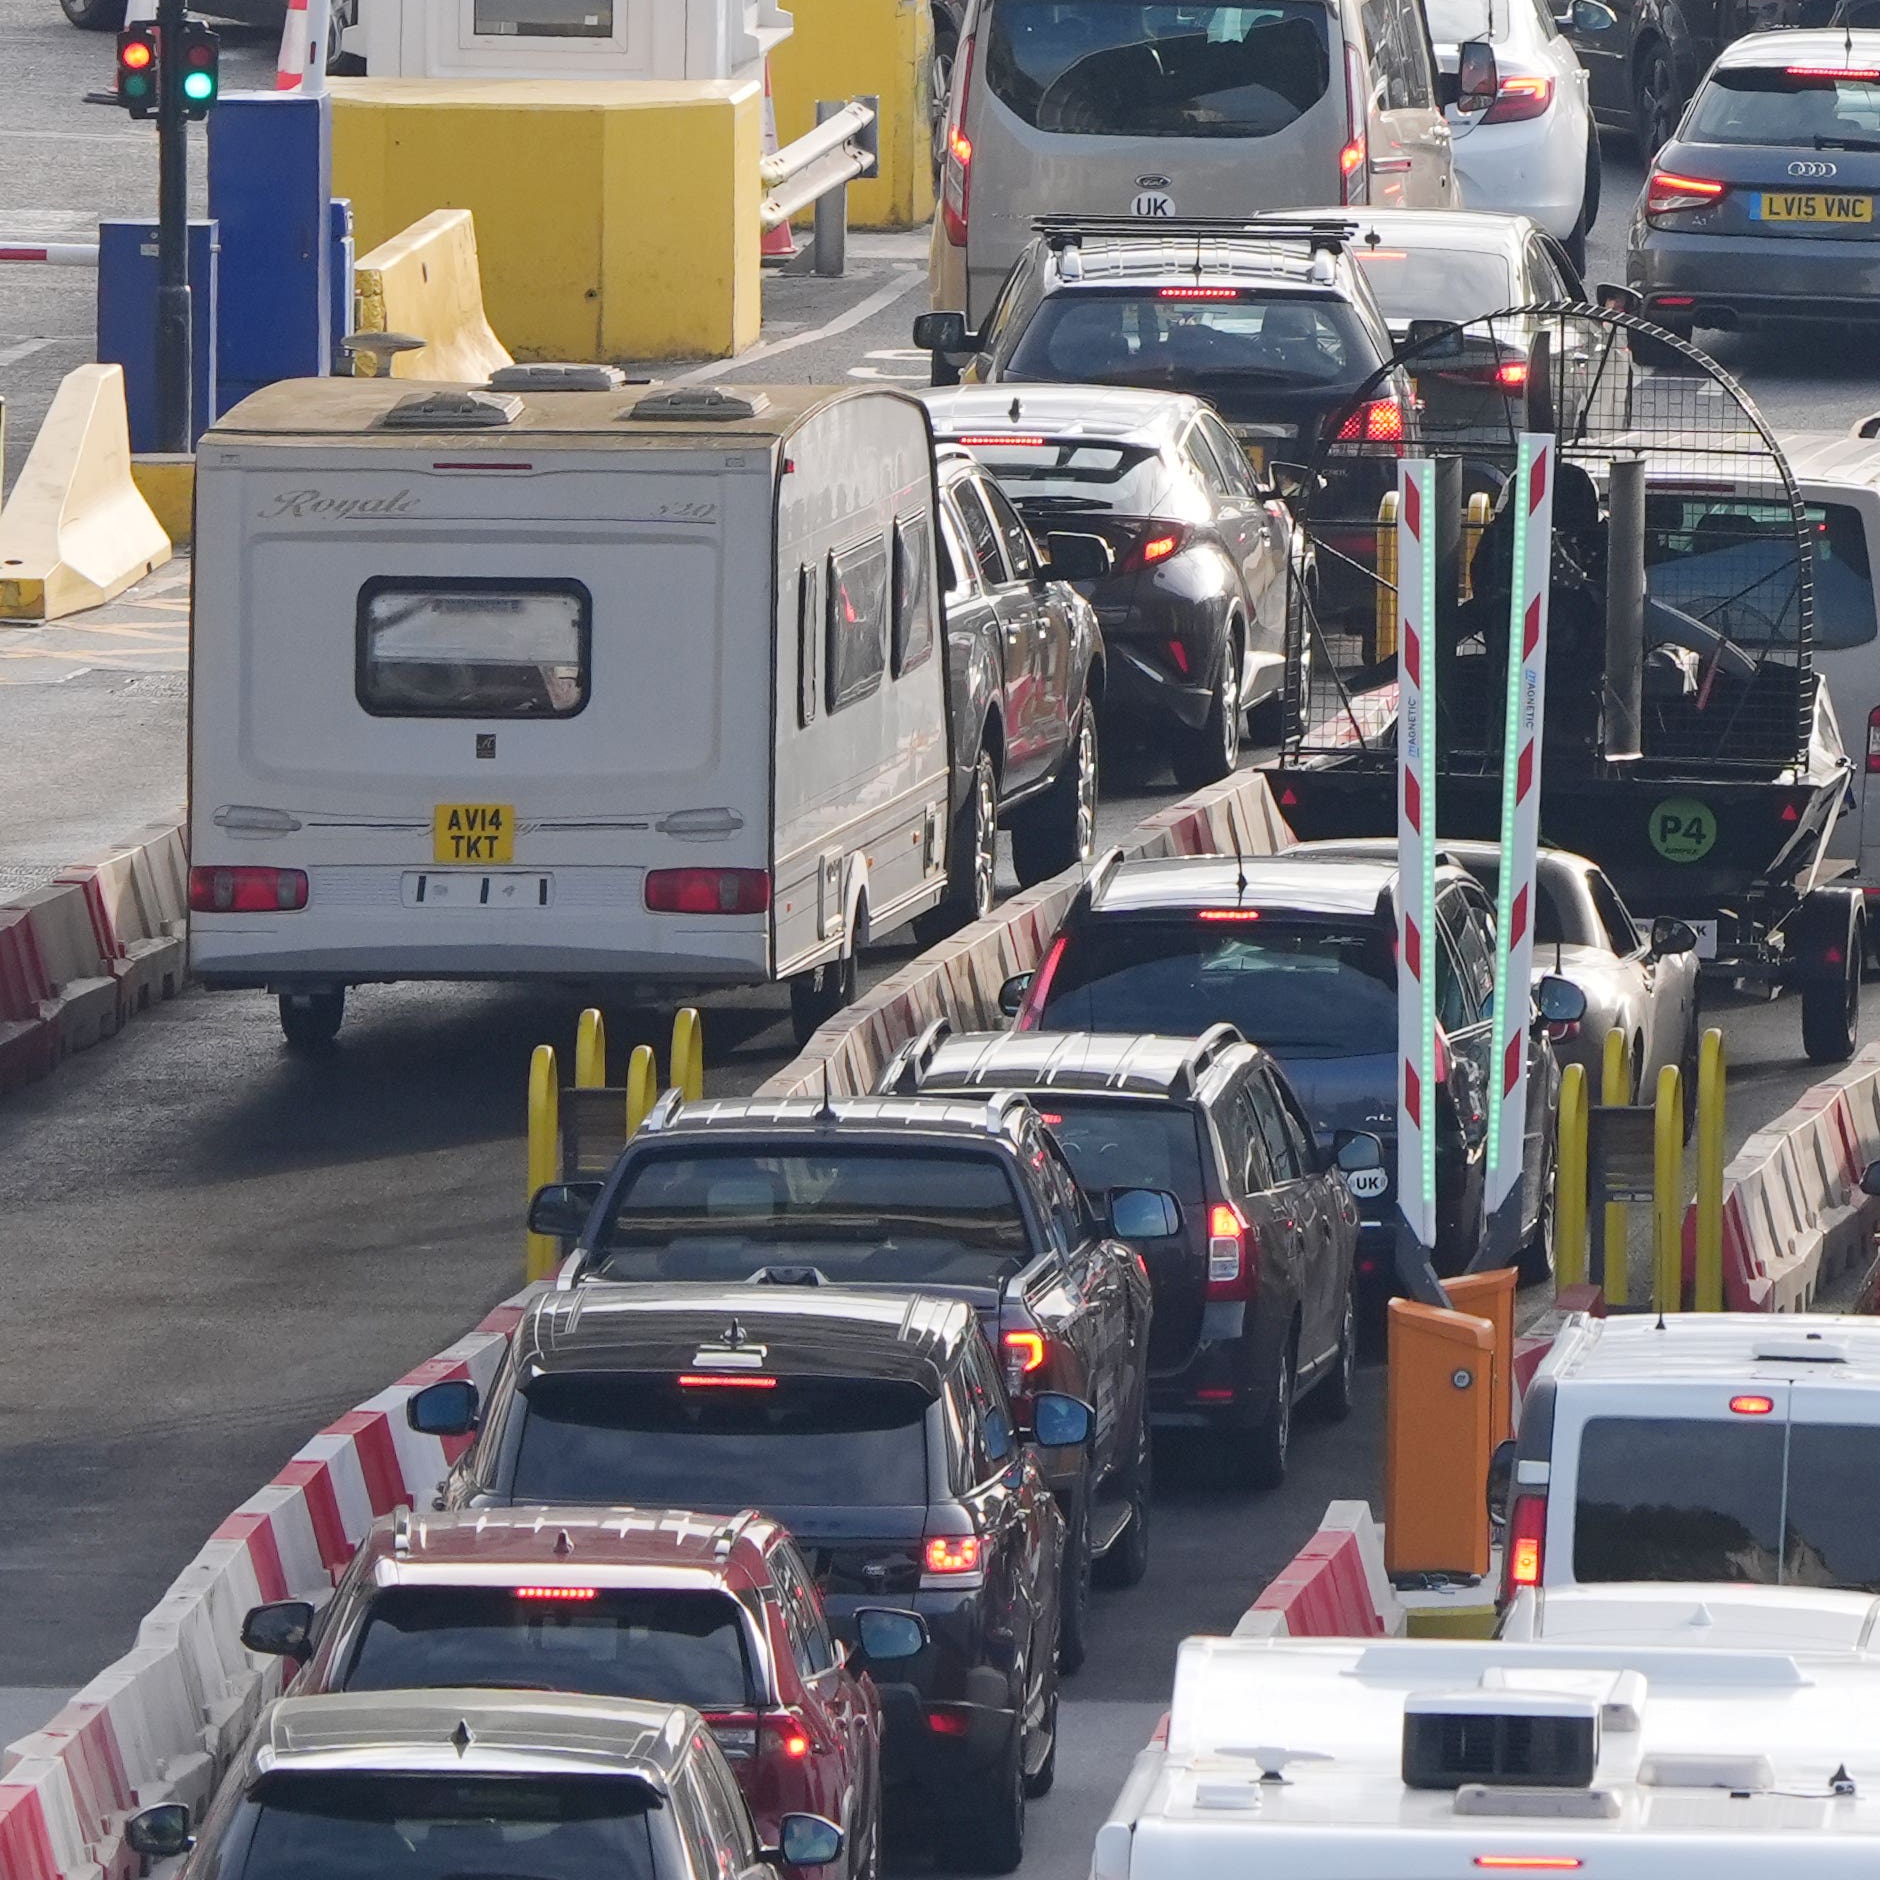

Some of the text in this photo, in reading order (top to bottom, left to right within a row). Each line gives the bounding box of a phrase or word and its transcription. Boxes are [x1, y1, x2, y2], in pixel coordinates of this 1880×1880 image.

[1138, 196, 1170, 217] UK
[1766, 196, 1865, 219] LV15 VNC
[258, 487, 422, 521] Royale
[448, 808, 503, 831] AV14
[1660, 815, 1706, 847] P4
[450, 835, 500, 859] TKT
[1357, 1176, 1379, 1190] UK
